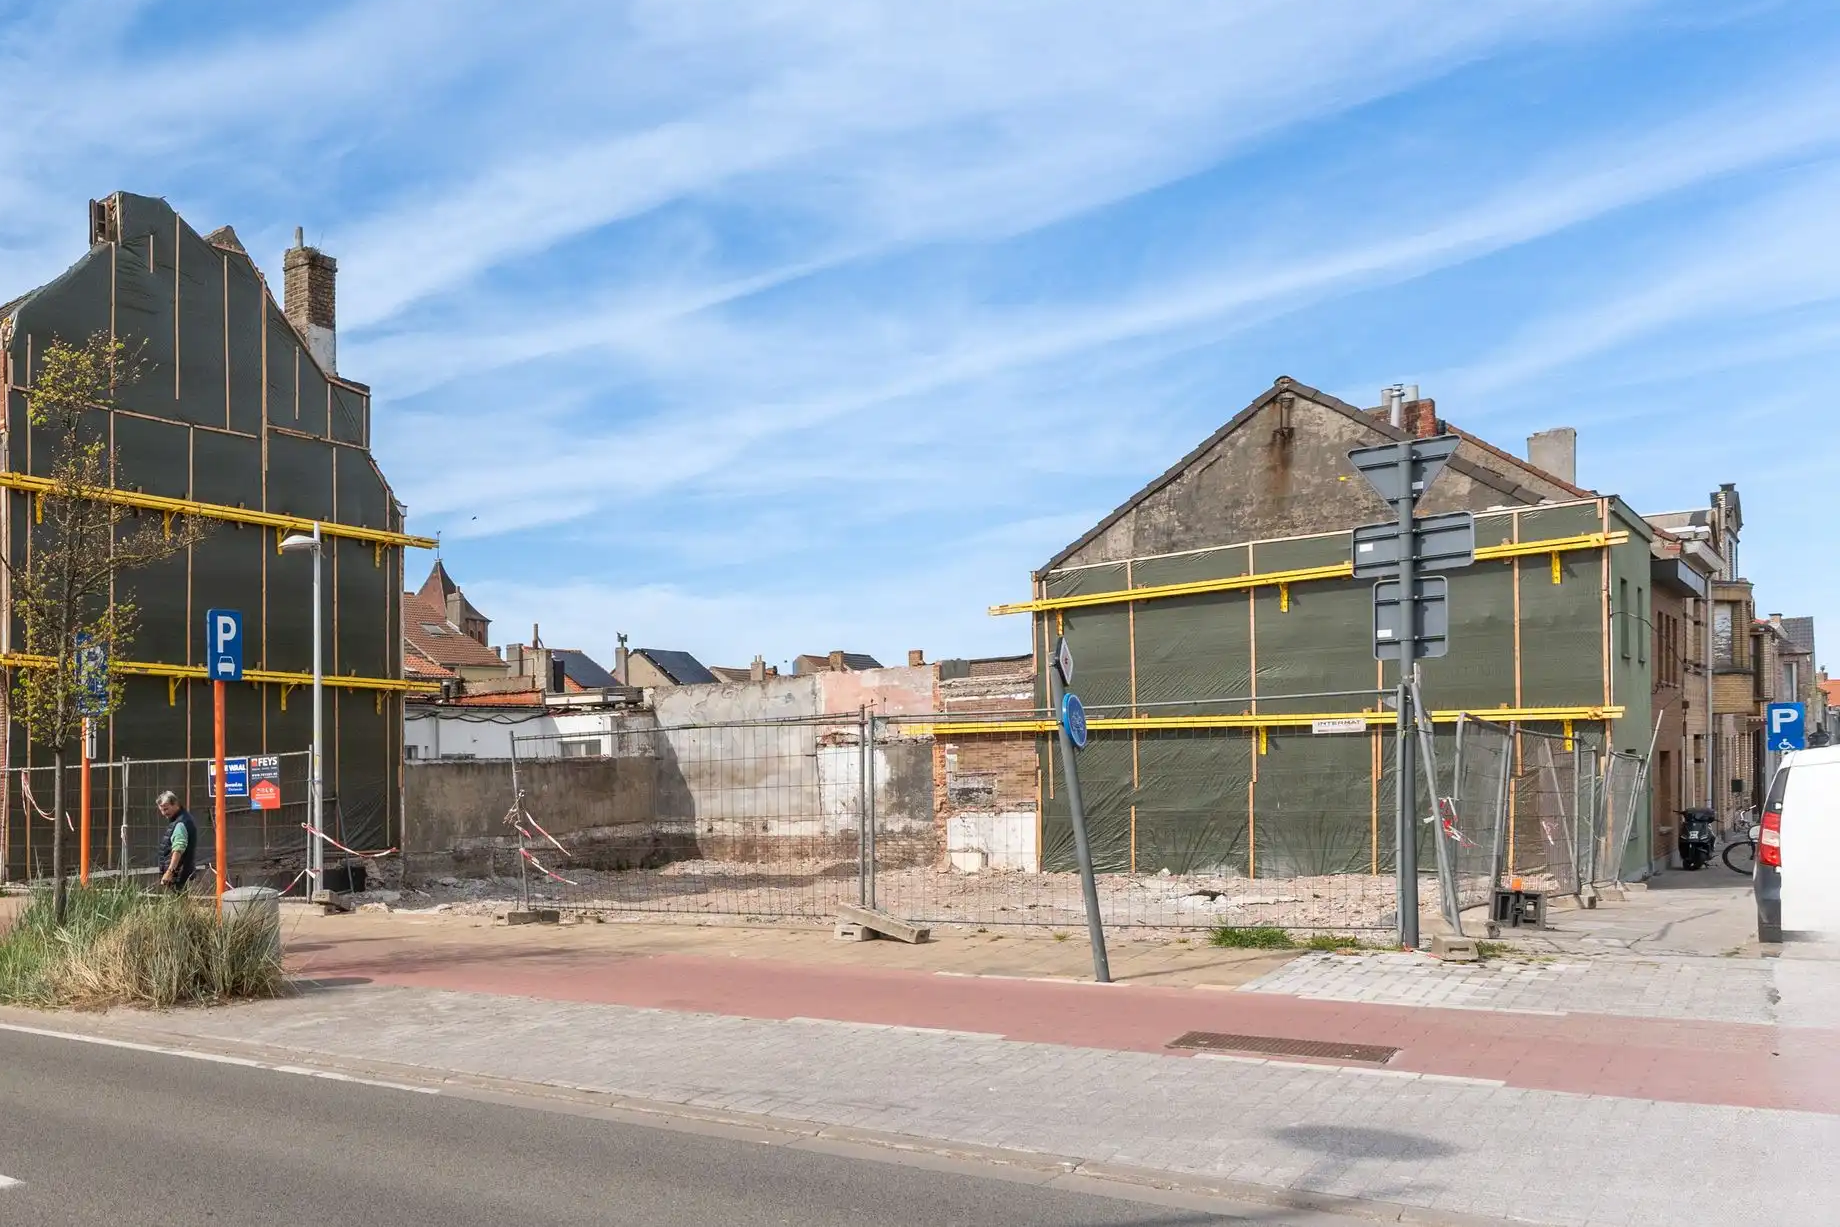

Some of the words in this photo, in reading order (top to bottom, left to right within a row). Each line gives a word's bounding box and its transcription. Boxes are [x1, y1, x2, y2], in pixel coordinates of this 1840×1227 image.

[217, 615, 237, 653] P
[1772, 708, 1799, 734] P
[258, 756, 278, 767] FEYS
